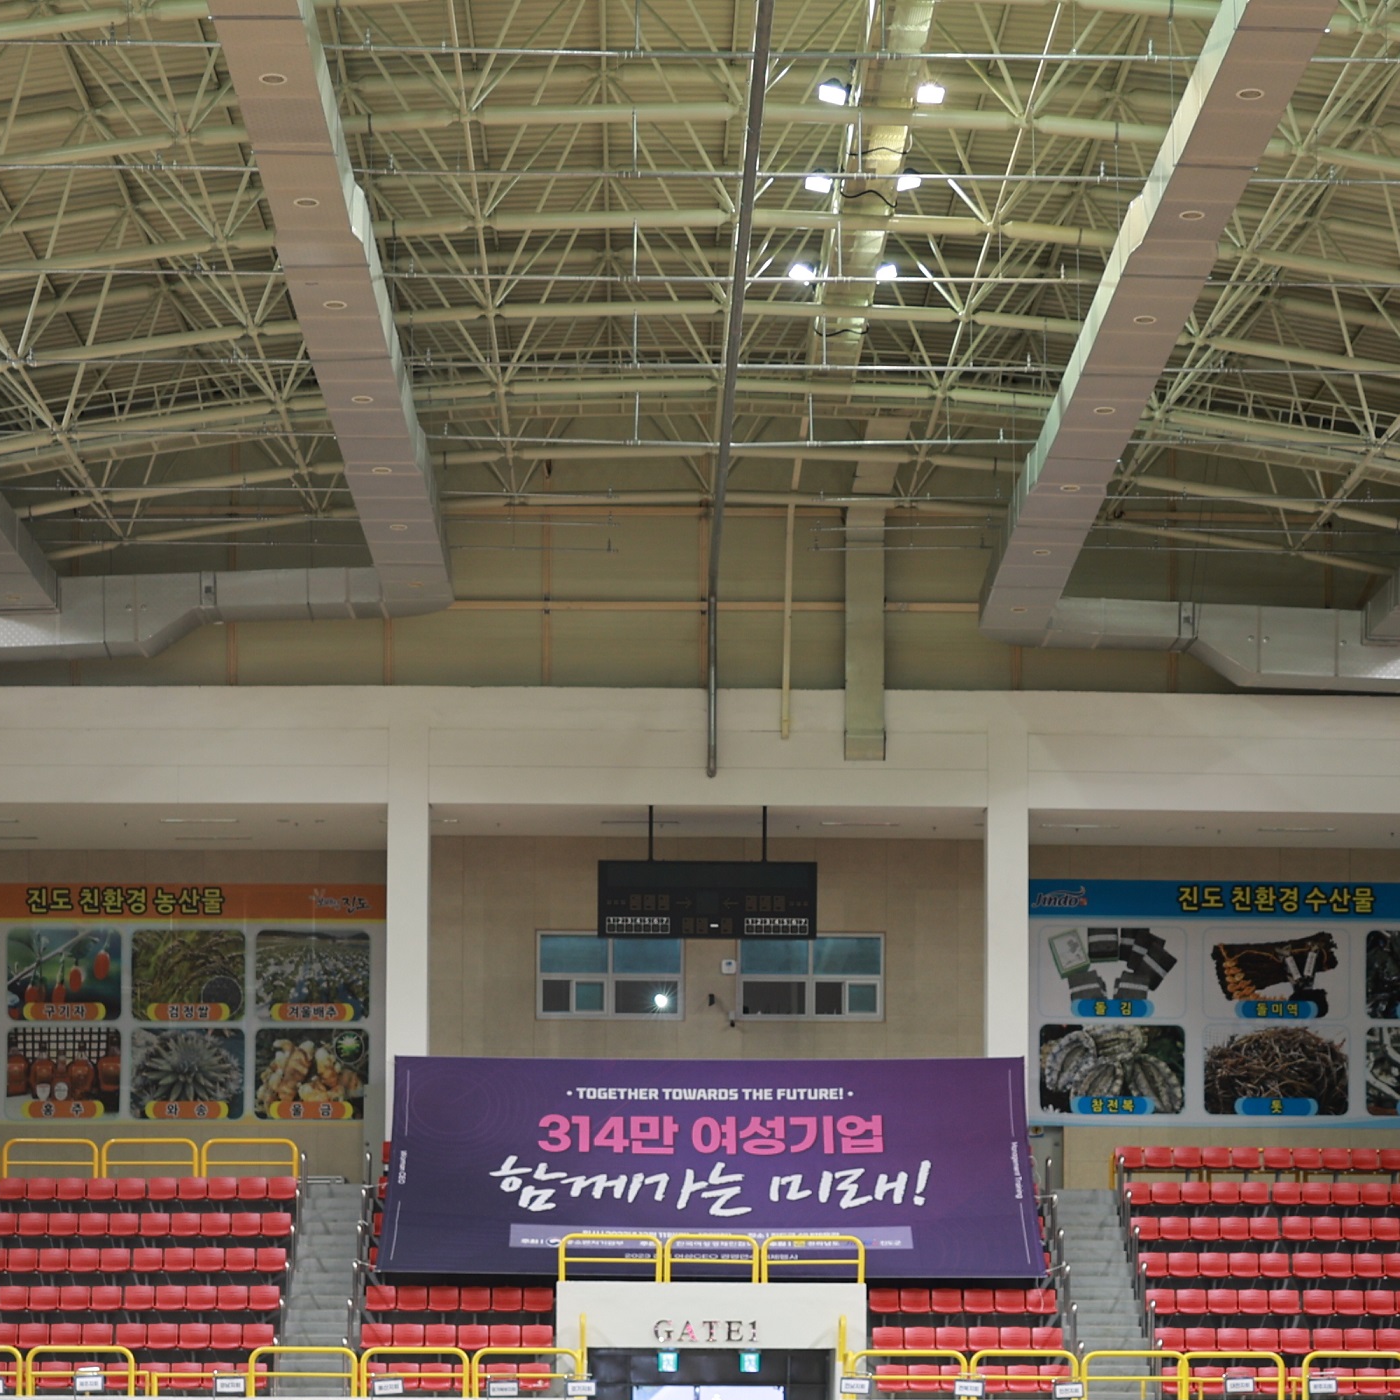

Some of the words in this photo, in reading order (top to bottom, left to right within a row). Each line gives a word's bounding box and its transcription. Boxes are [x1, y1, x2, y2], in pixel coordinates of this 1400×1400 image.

[26, 887, 73, 913] 진도
[79, 887, 148, 913] 친환경
[154, 886, 225, 914] 농산물
[1178, 885, 1224, 911] 진도
[1230, 886, 1299, 912] 친환경
[1305, 885, 1376, 914] 수산물
[43, 1004, 87, 1019] 구기자
[167, 1004, 210, 1019] 검정쌀
[287, 1004, 338, 1019] 겨울배추
[1256, 1002, 1299, 1017] 돌미역
[576, 1087, 659, 1100] TOGETHER
[662, 1088, 738, 1101] TOWARDS
[741, 1089, 773, 1100] THE
[776, 1088, 844, 1100] FUTURE!
[1091, 1098, 1134, 1113] 참전복
[1270, 1098, 1284, 1115] 톳
[537, 1114, 679, 1155] 314만
[691, 1114, 884, 1156] 여성기업
[489, 1155, 752, 1217] 함께가는
[769, 1159, 931, 1209] 미래!
[653, 1320, 760, 1343] GATE1
